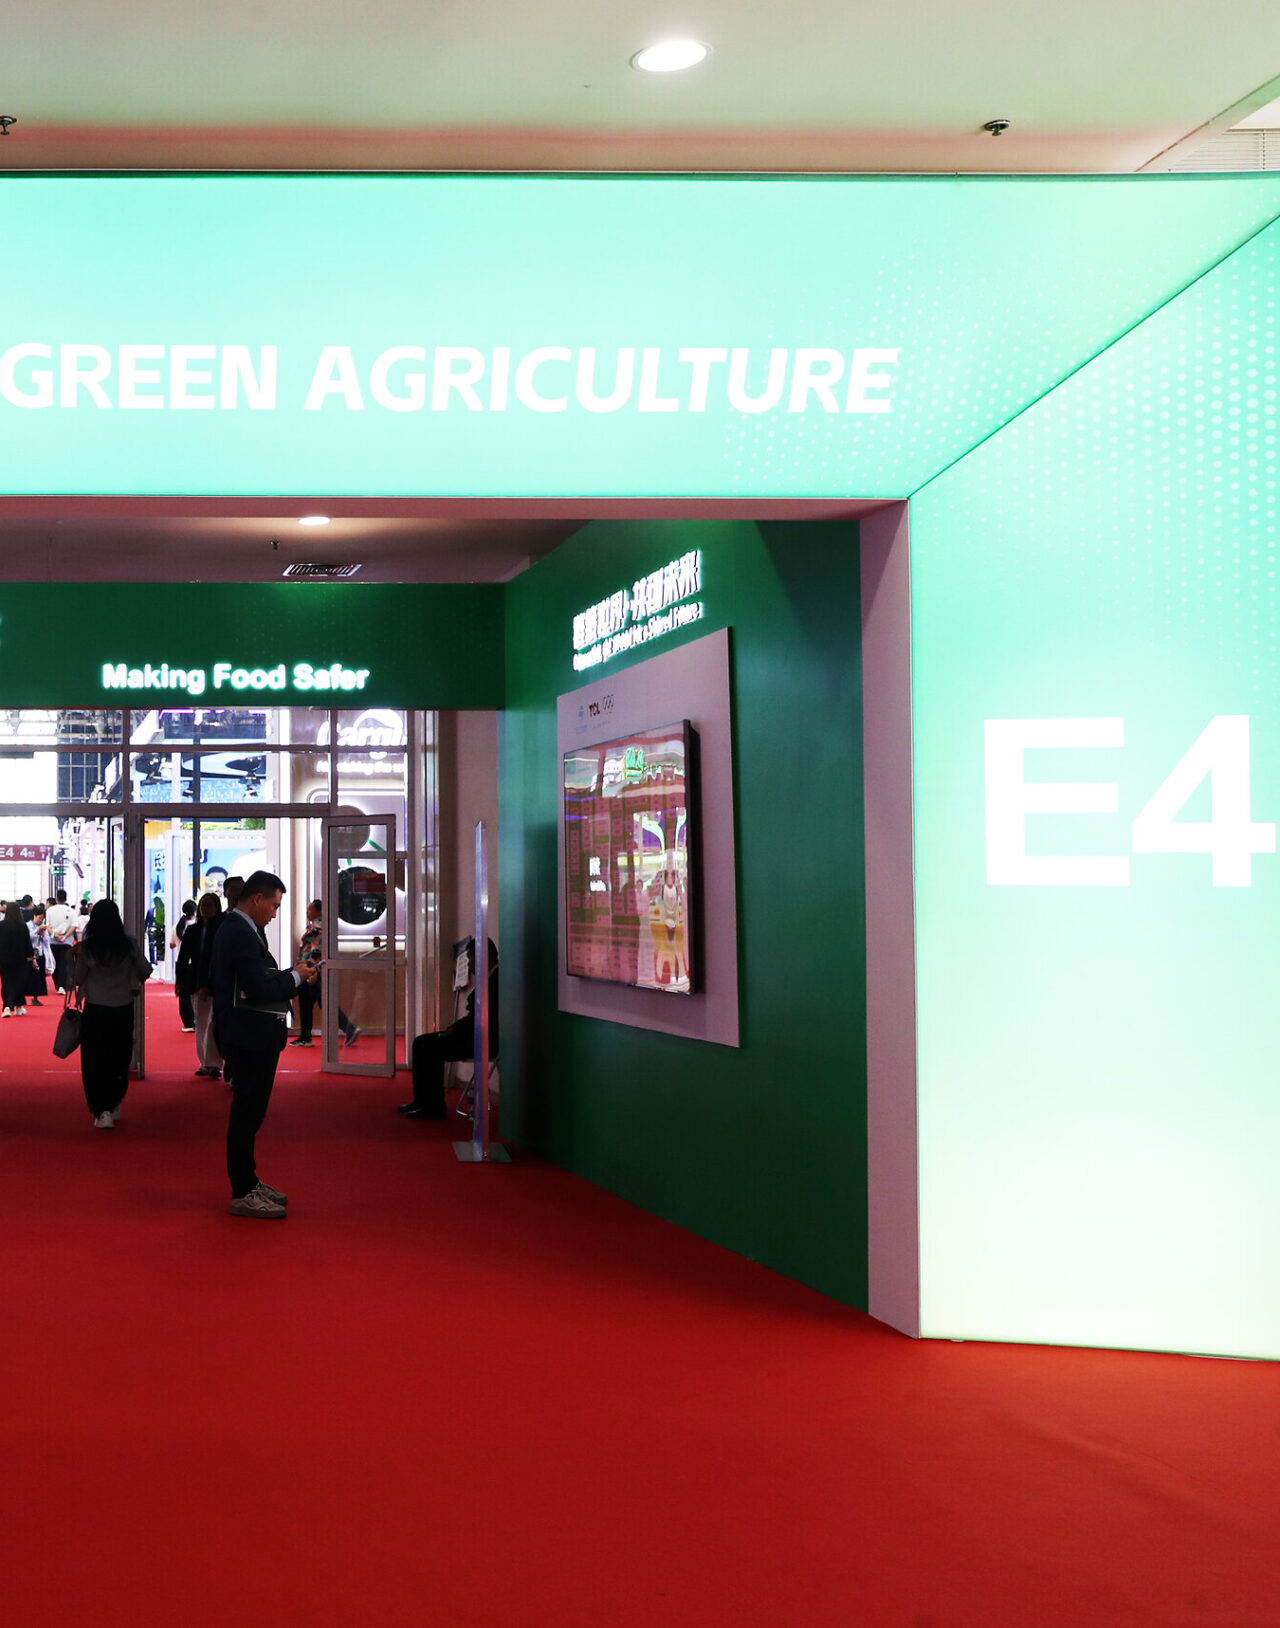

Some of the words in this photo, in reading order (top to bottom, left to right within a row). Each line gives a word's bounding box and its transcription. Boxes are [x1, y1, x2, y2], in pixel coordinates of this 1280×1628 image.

[302, 346, 902, 414] AGRICULTURE
[102, 663, 205, 694] Making
[213, 663, 286, 689] Food
[293, 663, 370, 689] Safer
[984, 714, 1277, 887] E4
